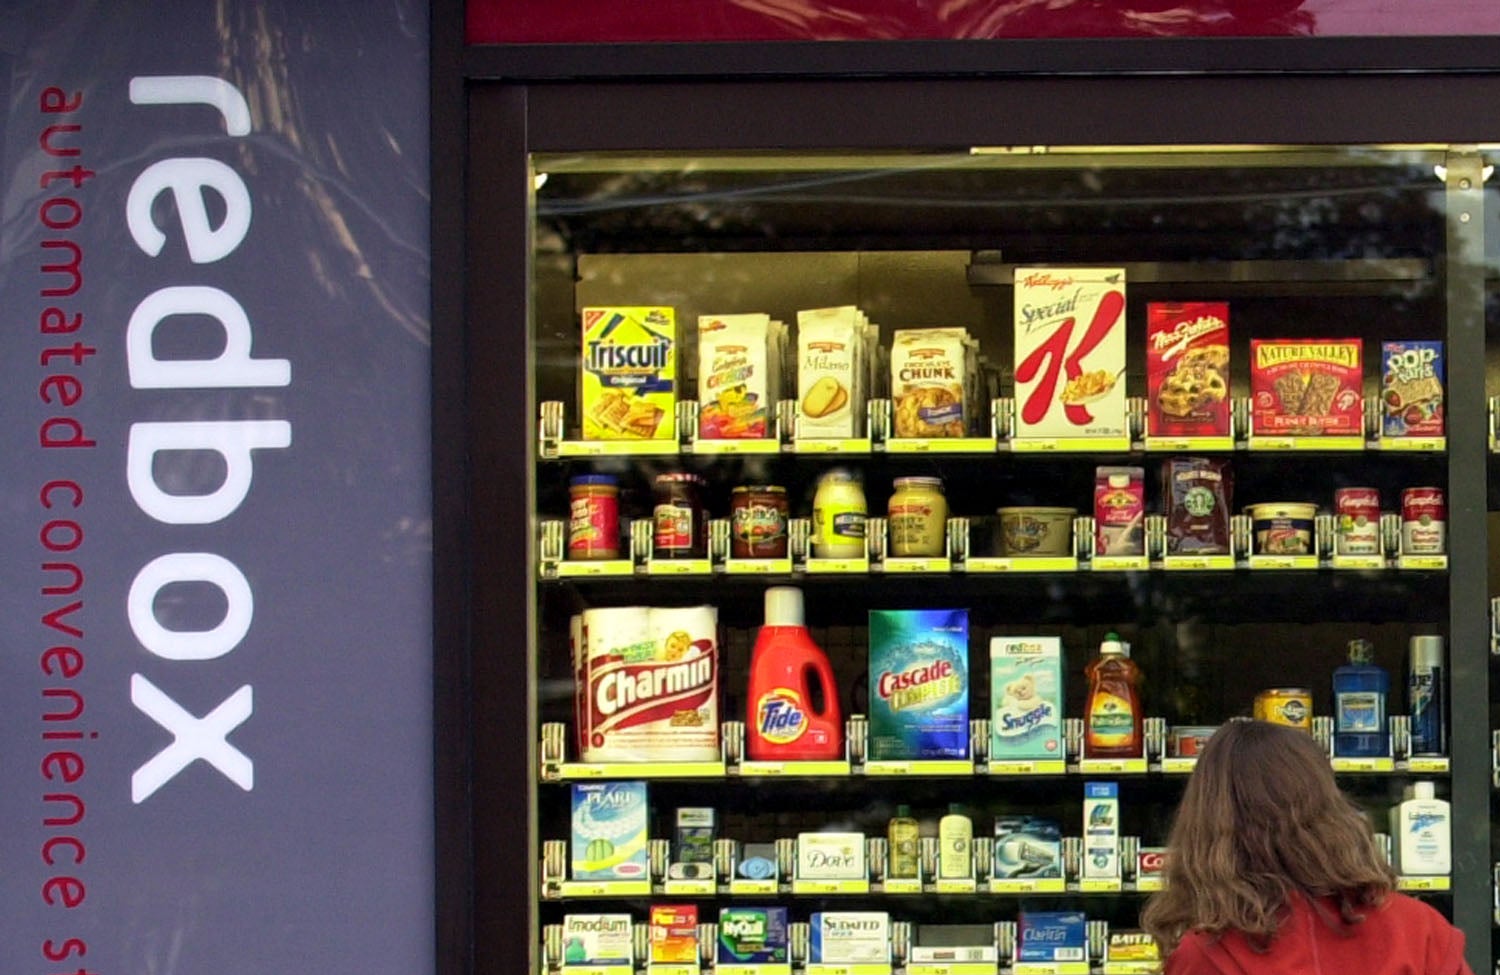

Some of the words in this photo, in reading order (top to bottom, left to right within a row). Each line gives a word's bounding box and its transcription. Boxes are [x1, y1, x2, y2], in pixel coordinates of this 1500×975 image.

[39, 85, 97, 449] automated
[1020, 287, 1083, 332] Special
[588, 339, 669, 368] Triscuit
[801, 355, 850, 372] Milano
[1014, 290, 1125, 427] K
[1259, 347, 1309, 366] NATURE
[1312, 346, 1354, 365] VALLEY
[899, 367, 955, 382] CHUNK
[126, 75, 292, 804] redbox
[40, 479, 99, 908] convenience
[596, 653, 712, 717] Charmin
[879, 659, 951, 700] Cascade
[762, 698, 802, 736] Tide
[1001, 700, 1051, 731] Snuggle
[806, 852, 855, 871] Dove
[567, 918, 628, 932] Imodium
[823, 916, 881, 931] SUDAFED
[1023, 927, 1067, 944] Claritin
